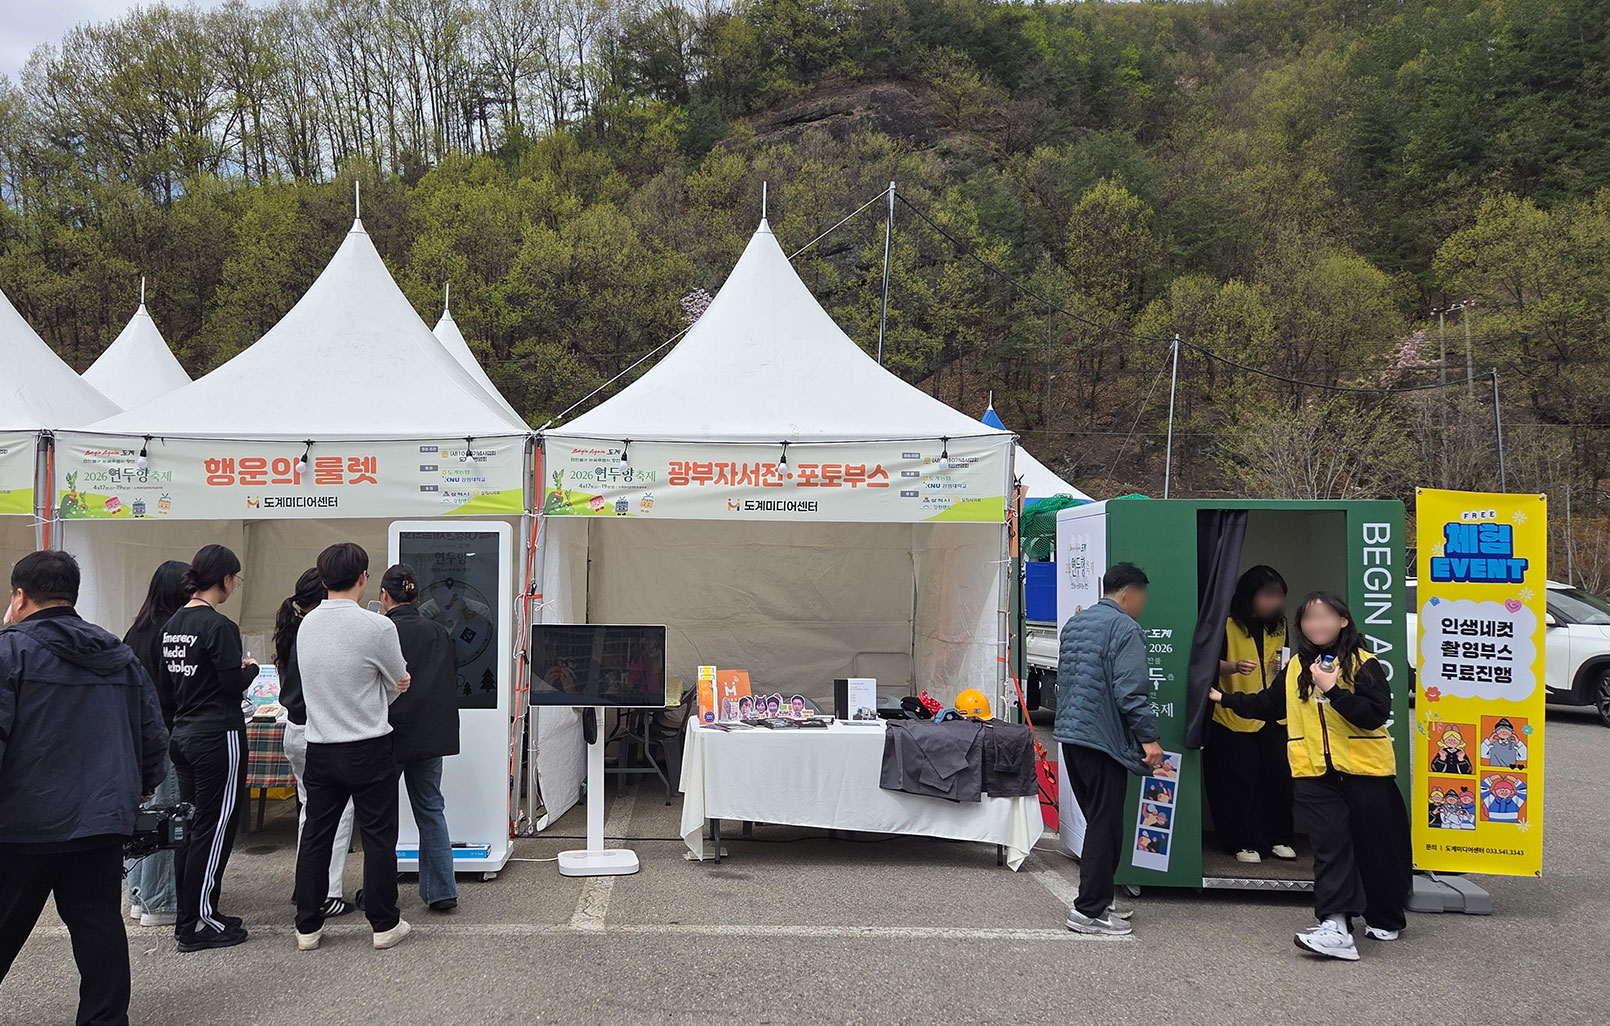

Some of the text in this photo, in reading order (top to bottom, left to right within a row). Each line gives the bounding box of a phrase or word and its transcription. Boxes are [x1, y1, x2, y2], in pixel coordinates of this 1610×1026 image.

[84, 471, 108, 482] 2026
[151, 470, 173, 482] 축제
[203, 456, 378, 487] 행운의 룰렛
[570, 470, 594, 480] 2026
[636, 470, 656, 482] 축제
[264, 496, 338, 508] 도계미디어센터
[744, 500, 818, 512] 도계미디어센터
[1462, 510, 1496, 520] FREE
[1445, 523, 1512, 555] 체험
[1362, 522, 1393, 625] BEGIN
[1432, 558, 1527, 580] EVENT
[1148, 628, 1173, 638] 도계
[1441, 617, 1514, 638] 인생네컷
[1149, 643, 1173, 653] 2026
[1441, 641, 1513, 661] 촬영부스
[1441, 663, 1513, 684] 무료진행
[1445, 845, 1485, 854] 도계미디어센터
